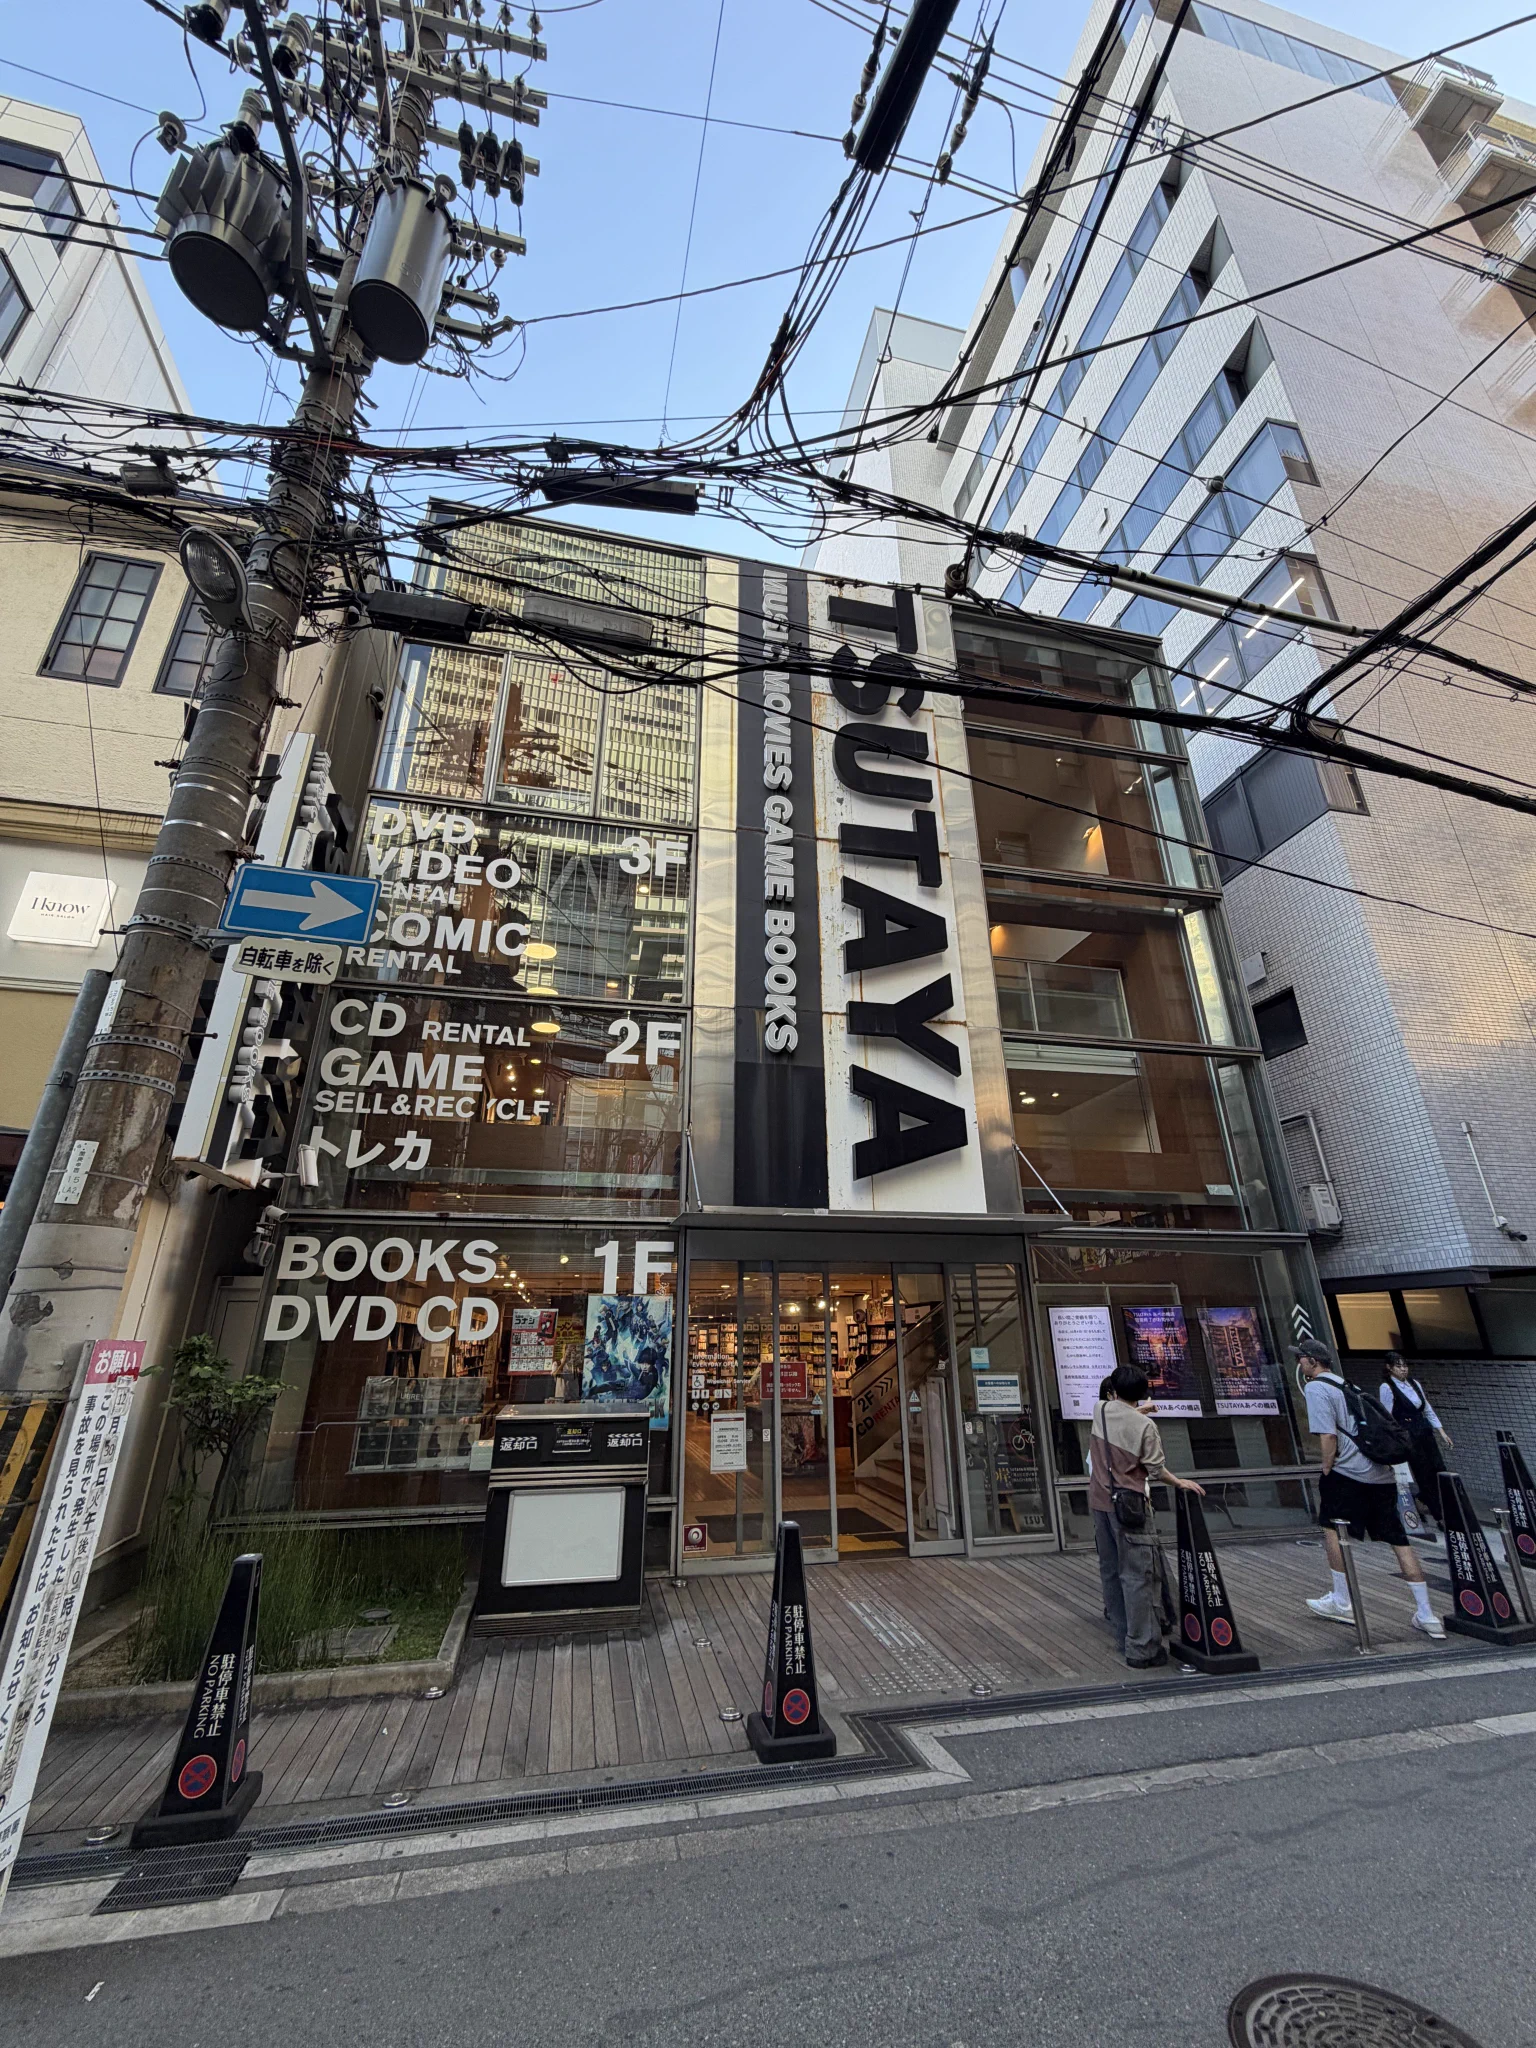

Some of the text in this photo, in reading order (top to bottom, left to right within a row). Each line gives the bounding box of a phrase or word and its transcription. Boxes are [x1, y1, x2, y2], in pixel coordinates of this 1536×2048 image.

[763, 669, 793, 791] MOVIES
[371, 807, 476, 844] DVD
[764, 795, 795, 902] GAME
[366, 844, 521, 889] VIDEO
[620, 836, 688, 877] 3F
[380, 881, 462, 905] ENTAL
[827, 589, 969, 1181] TSUTAYA
[238, 946, 335, 976] 自転車を除く
[346, 946, 462, 975] RENTAL
[765, 909, 798, 1053] BOOKS
[331, 999, 531, 1047] CD RENTAL
[606, 1020, 682, 1065] 2F
[320, 1047, 485, 1092] GAME
[309, 1126, 432, 1172] トレカ
[276, 1236, 499, 1284] BOOKS
[594, 1240, 675, 1295] 1F
[263, 1295, 500, 1342] DVD CD
[95, 1350, 137, 1374] お願い
[857, 1390, 875, 1413] 2F
[873, 1396, 900, 1423] RENTA
[500, 1440, 538, 1452] 返却口
[607, 1437, 643, 1448] 返却口
[35, 1395, 98, 1593] 事故を見られた方は
[52, 1395, 112, 1586] この場所で発生した
[1198, 1552, 1206, 1567] NO
[784, 1605, 794, 1675] NO PARKING
[793, 1604, 807, 1675] 駐停車禁止
[193, 1654, 221, 1739] NO PARKING
[206, 1652, 236, 1738] 駐停車禁止
